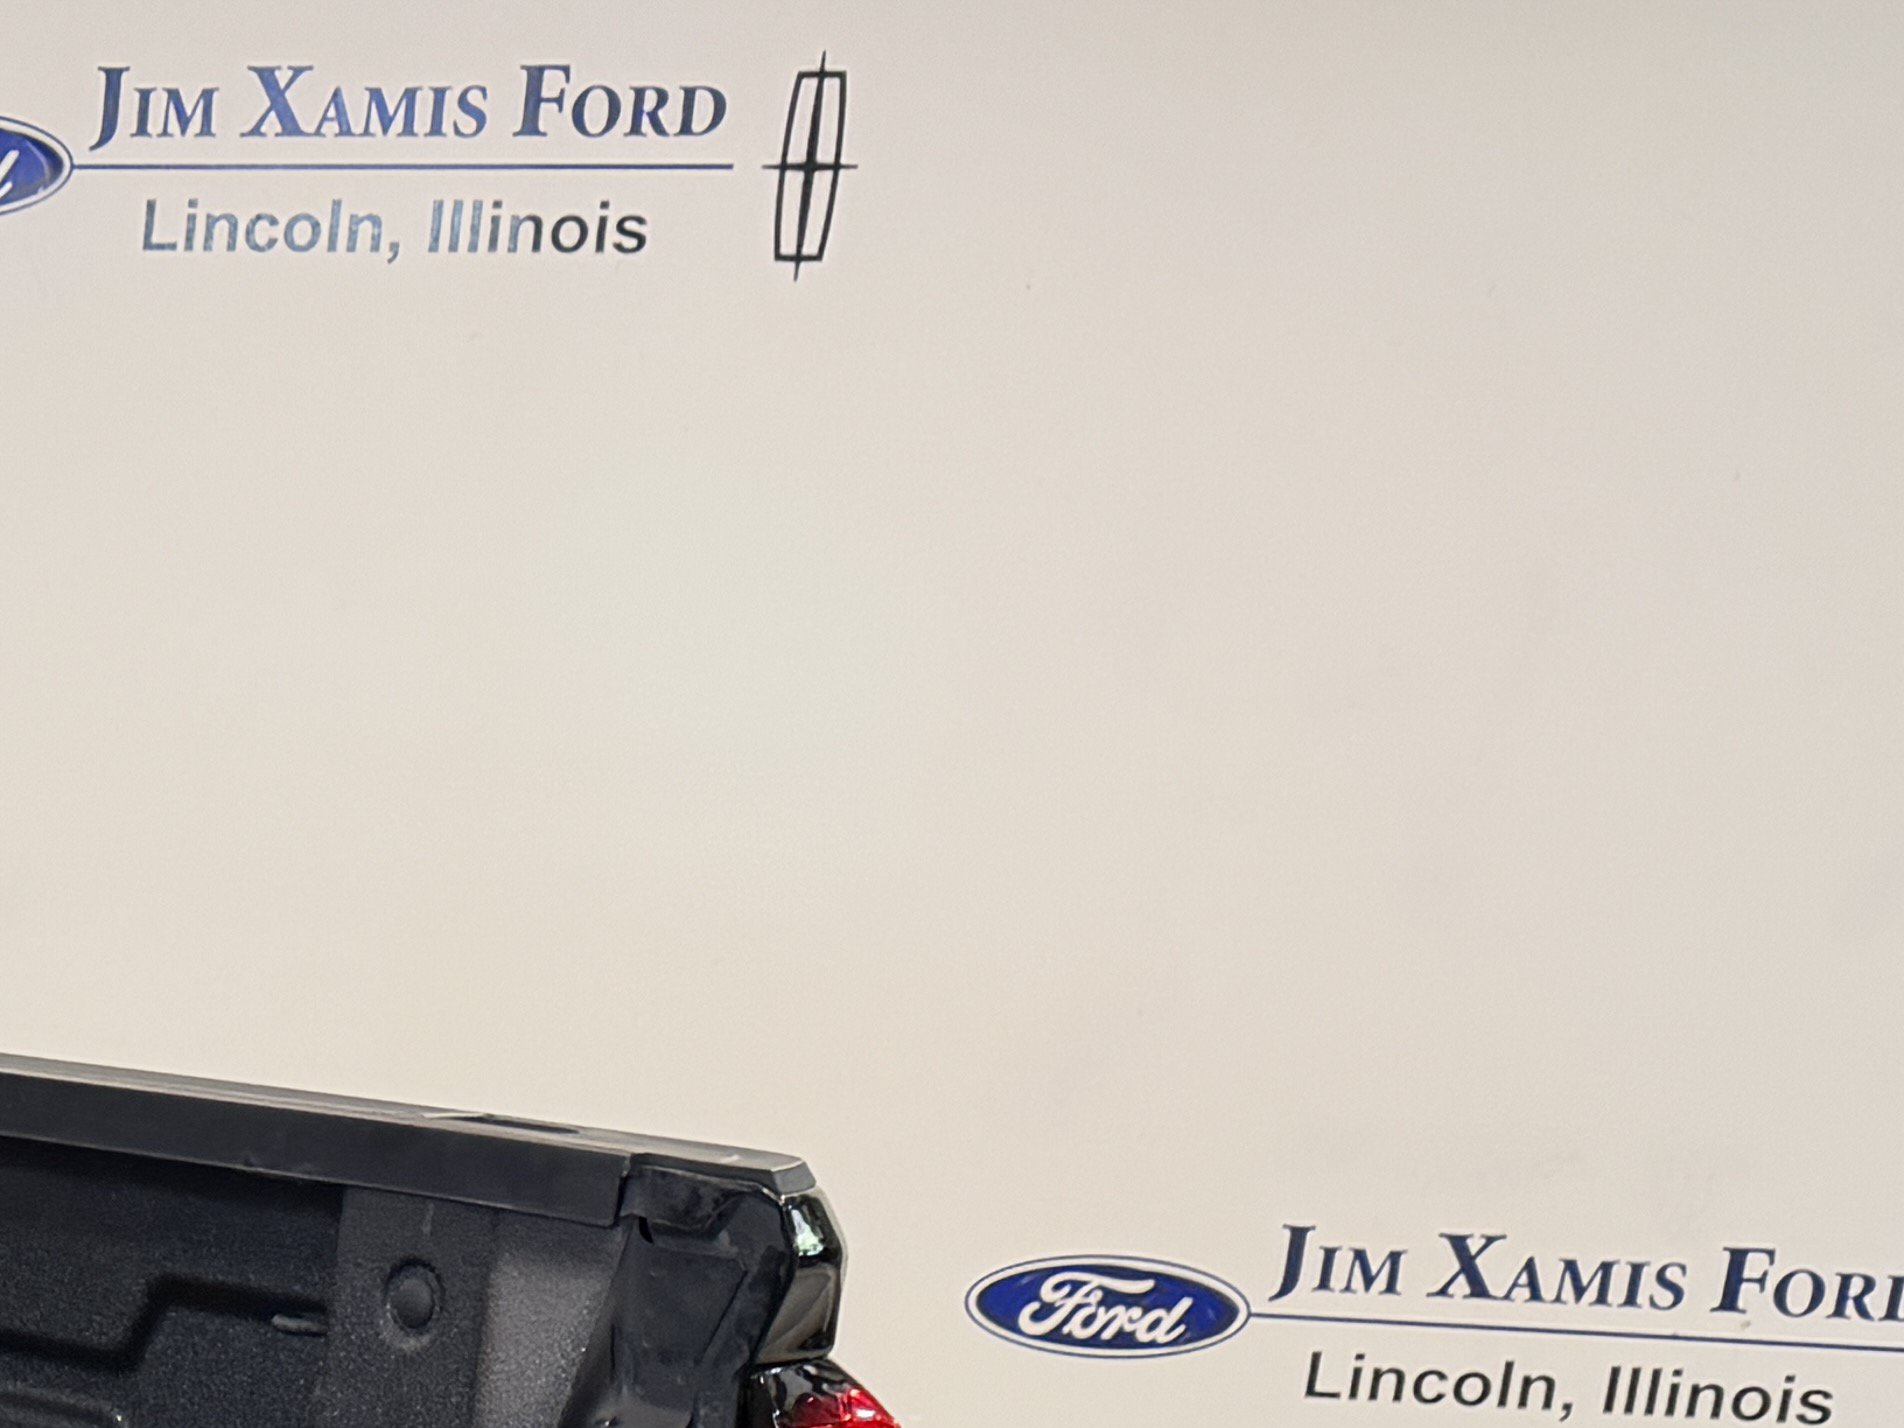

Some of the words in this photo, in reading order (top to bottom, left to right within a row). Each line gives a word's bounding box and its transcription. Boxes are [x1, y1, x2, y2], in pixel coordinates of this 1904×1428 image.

[88, 66, 219, 152] JIM
[239, 65, 488, 138] XAMIS
[512, 64, 727, 138] FORD
[142, 199, 399, 264] Lincoln,
[426, 200, 647, 254] Illinois
[1268, 1224, 1406, 1302] JIM
[1426, 1232, 1687, 1311] XAMIS
[1018, 1271, 1194, 1344] Ford
[1304, 1351, 1573, 1422] Lincoln,
[1602, 1366, 1833, 1426] Illinois
